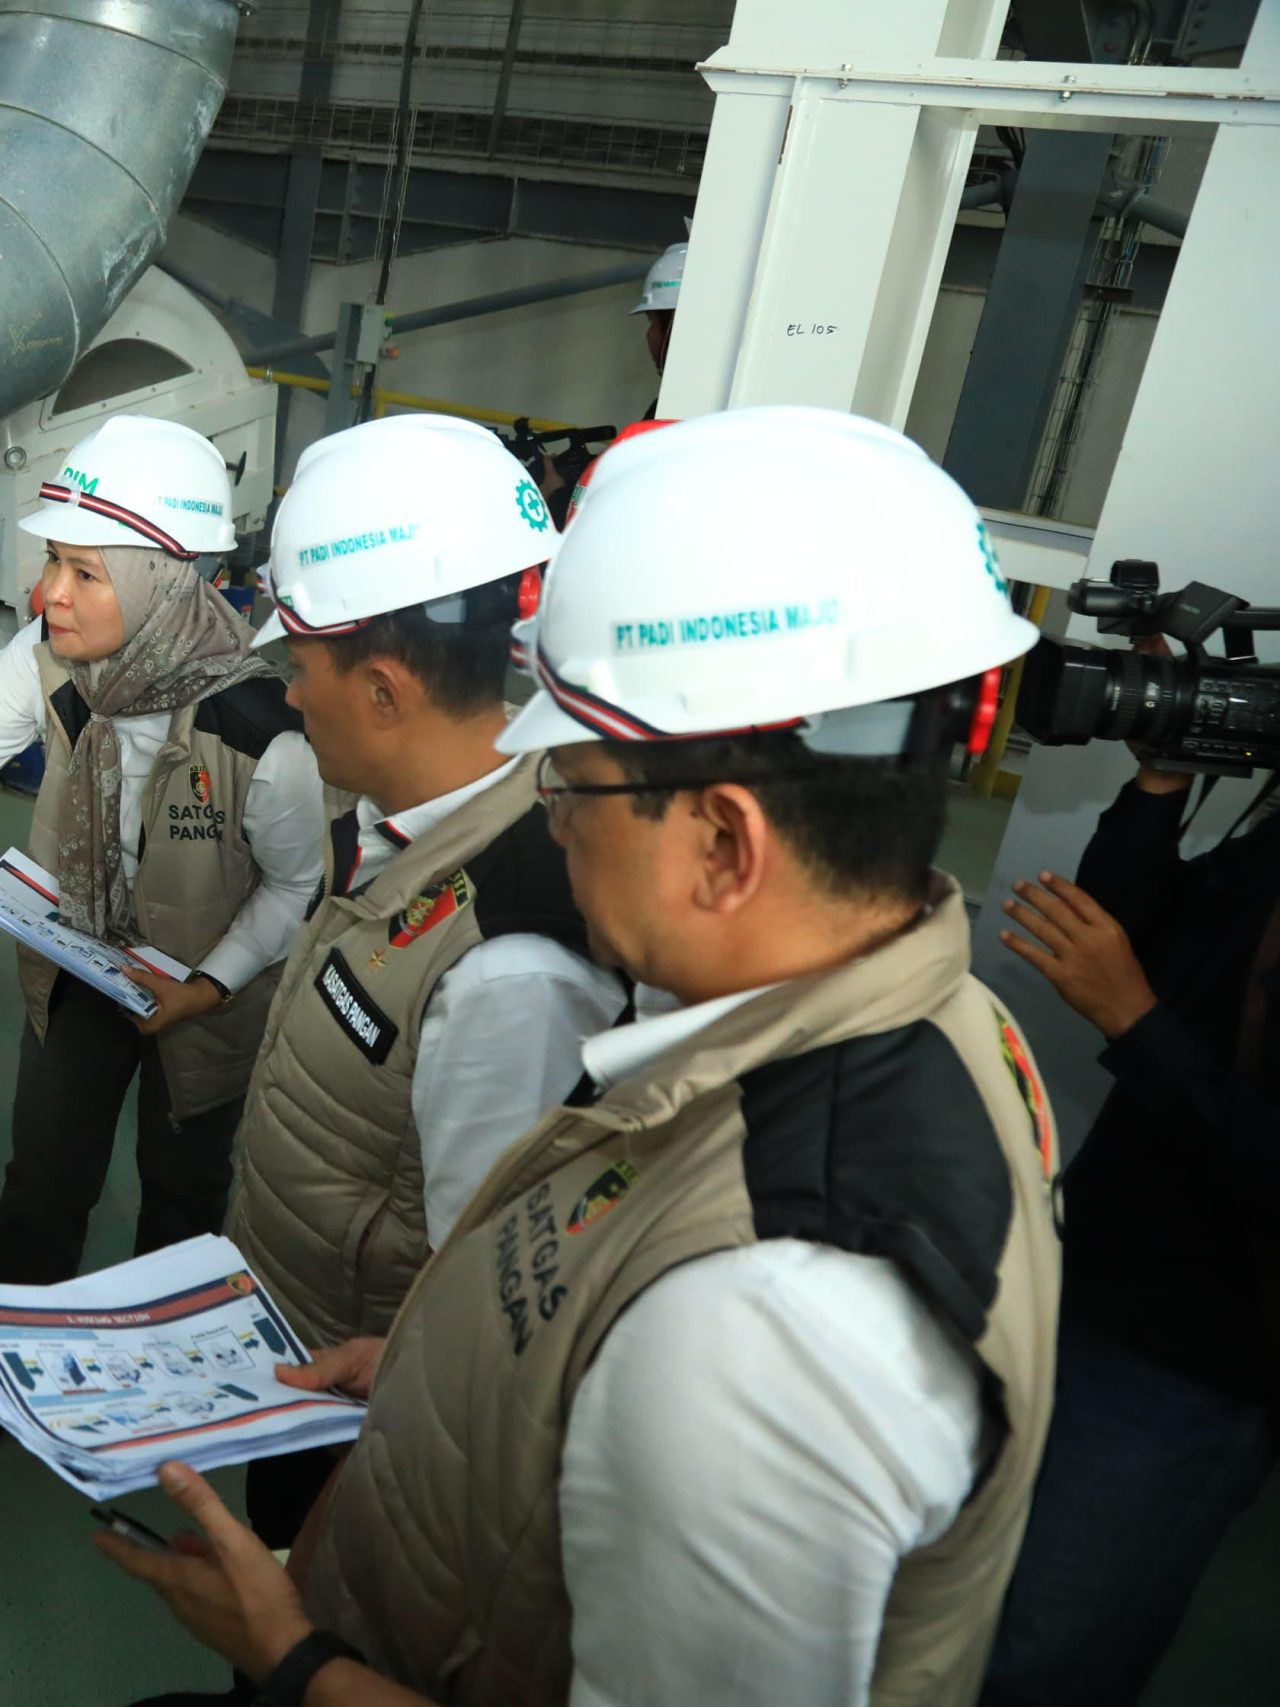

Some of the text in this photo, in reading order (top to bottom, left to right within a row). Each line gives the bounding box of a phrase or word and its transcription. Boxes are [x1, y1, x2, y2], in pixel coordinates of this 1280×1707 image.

[811, 323, 839, 335] 105
[310, 543, 330, 565] PADI
[331, 530, 387, 557] INDONESIA
[616, 623, 634, 650] PT
[638, 620, 675, 648] PADI
[679, 607, 781, 643] INDONESIA
[345, 1001, 381, 1048] PANGAN
[526, 1182, 568, 1323] SATGAS
